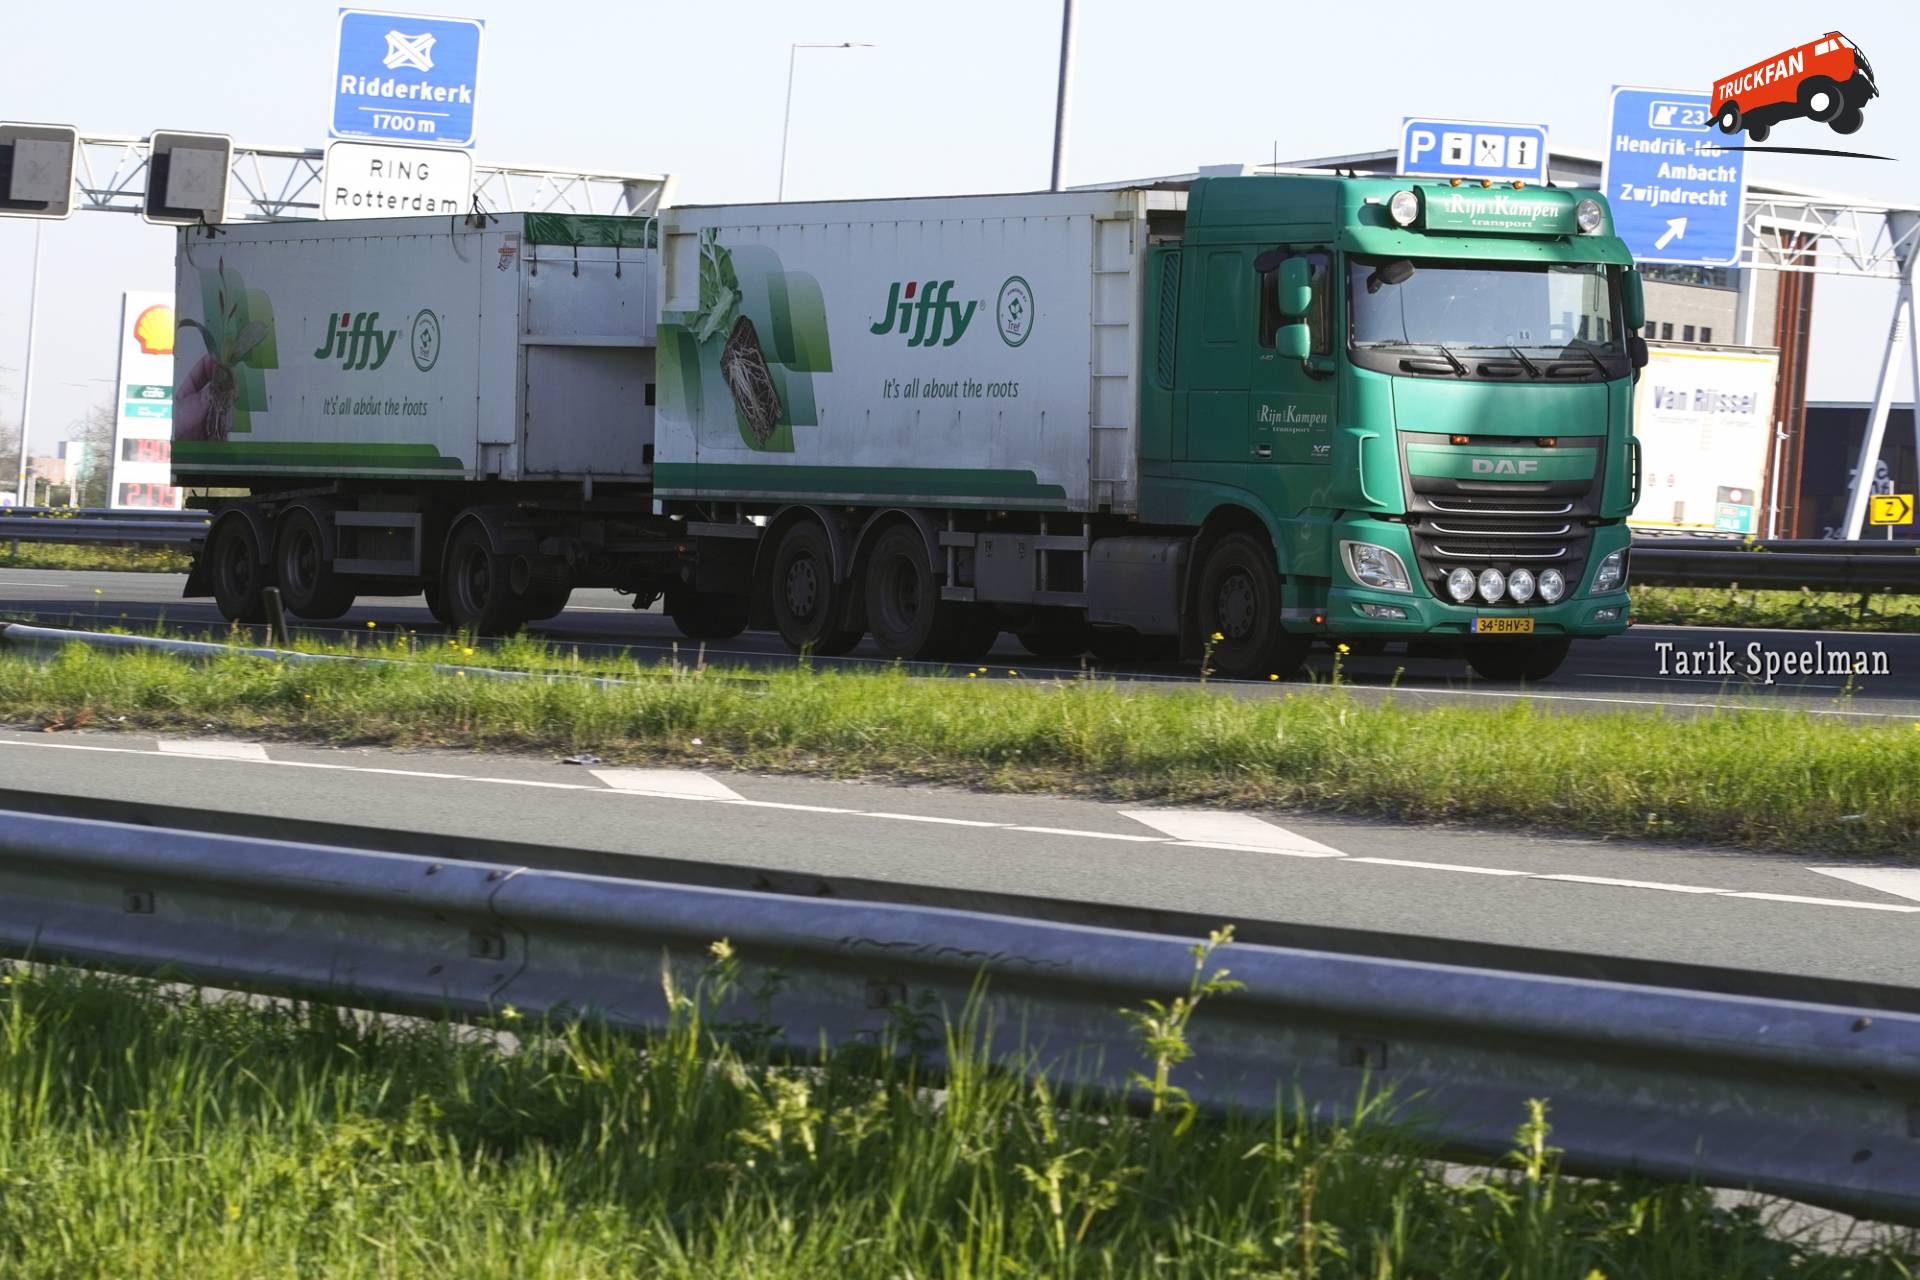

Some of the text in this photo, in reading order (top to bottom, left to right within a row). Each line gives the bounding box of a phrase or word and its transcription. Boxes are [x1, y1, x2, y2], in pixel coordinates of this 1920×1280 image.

[340, 75, 472, 104] Ridderkerk
[373, 114, 435, 133] 1700 m
[1680, 109, 1704, 126] 23
[370, 159, 430, 181] RING
[1657, 162, 1737, 183] Ambacht
[335, 187, 459, 214] Rotterdam
[1620, 184, 1728, 208] Zwijndrecht
[1451, 193, 1486, 219] Rijn
[1493, 195, 1559, 222] Kampen
[1471, 219, 1533, 229] transport
[869, 280, 978, 347] Jiffy
[313, 312, 398, 371] Jiffy
[883, 378, 1019, 399] It's all about the roots
[323, 397, 428, 416] It's all about the roots
[1654, 386, 1757, 415] Van Rijssel
[1260, 404, 1281, 425] Rijn
[1286, 405, 1328, 427] Kampen
[1313, 444, 1331, 453] XF
[1471, 459, 1538, 474] DAF
[1479, 619, 1531, 632] 34-BHV-3
